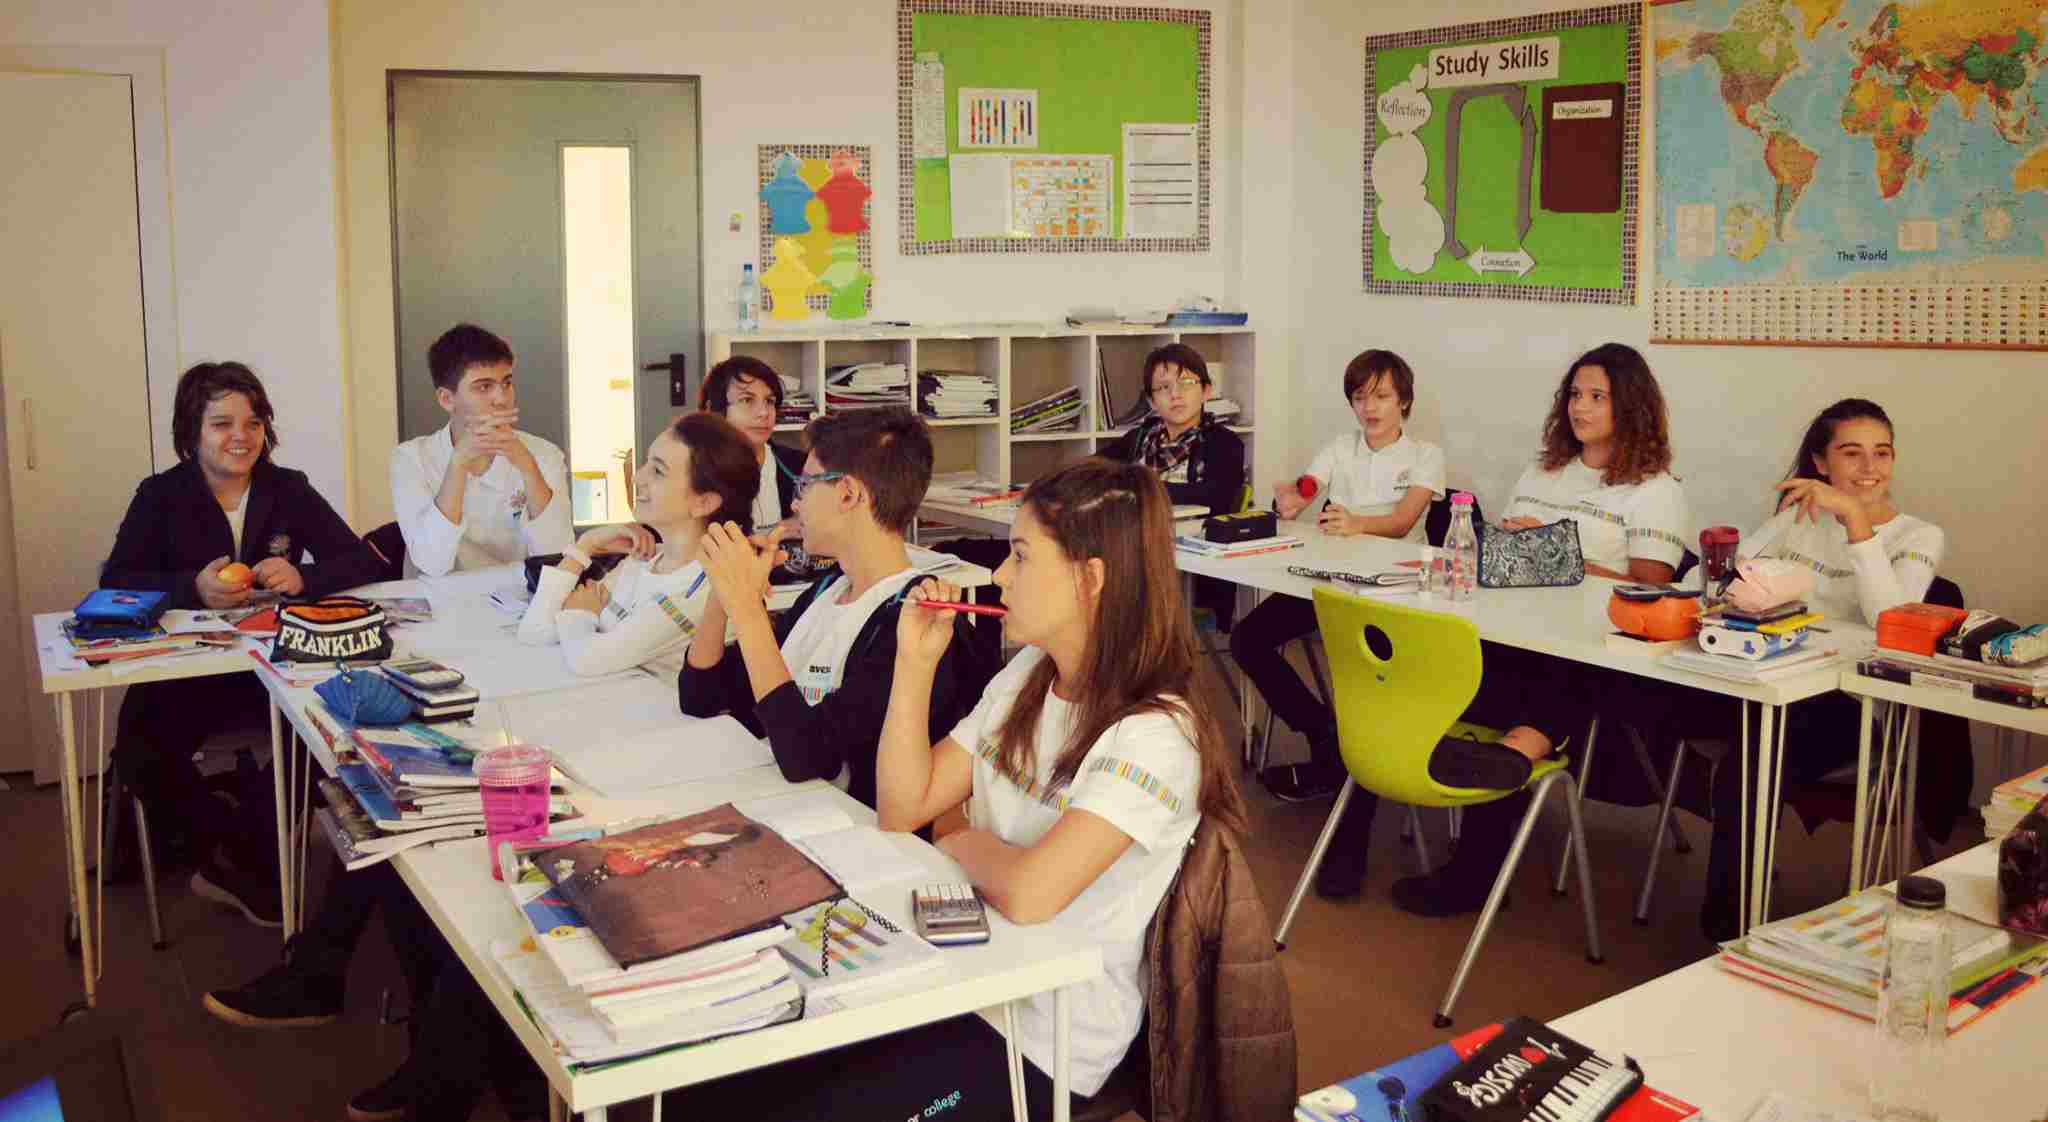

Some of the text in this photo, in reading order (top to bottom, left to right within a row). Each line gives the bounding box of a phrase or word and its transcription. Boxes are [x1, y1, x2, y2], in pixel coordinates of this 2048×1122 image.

[1435, 44, 1549, 77] Study Skills
[1836, 248, 1888, 262] The World
[278, 625, 383, 657] FRANKLIN
[923, 1090, 962, 1118] college
